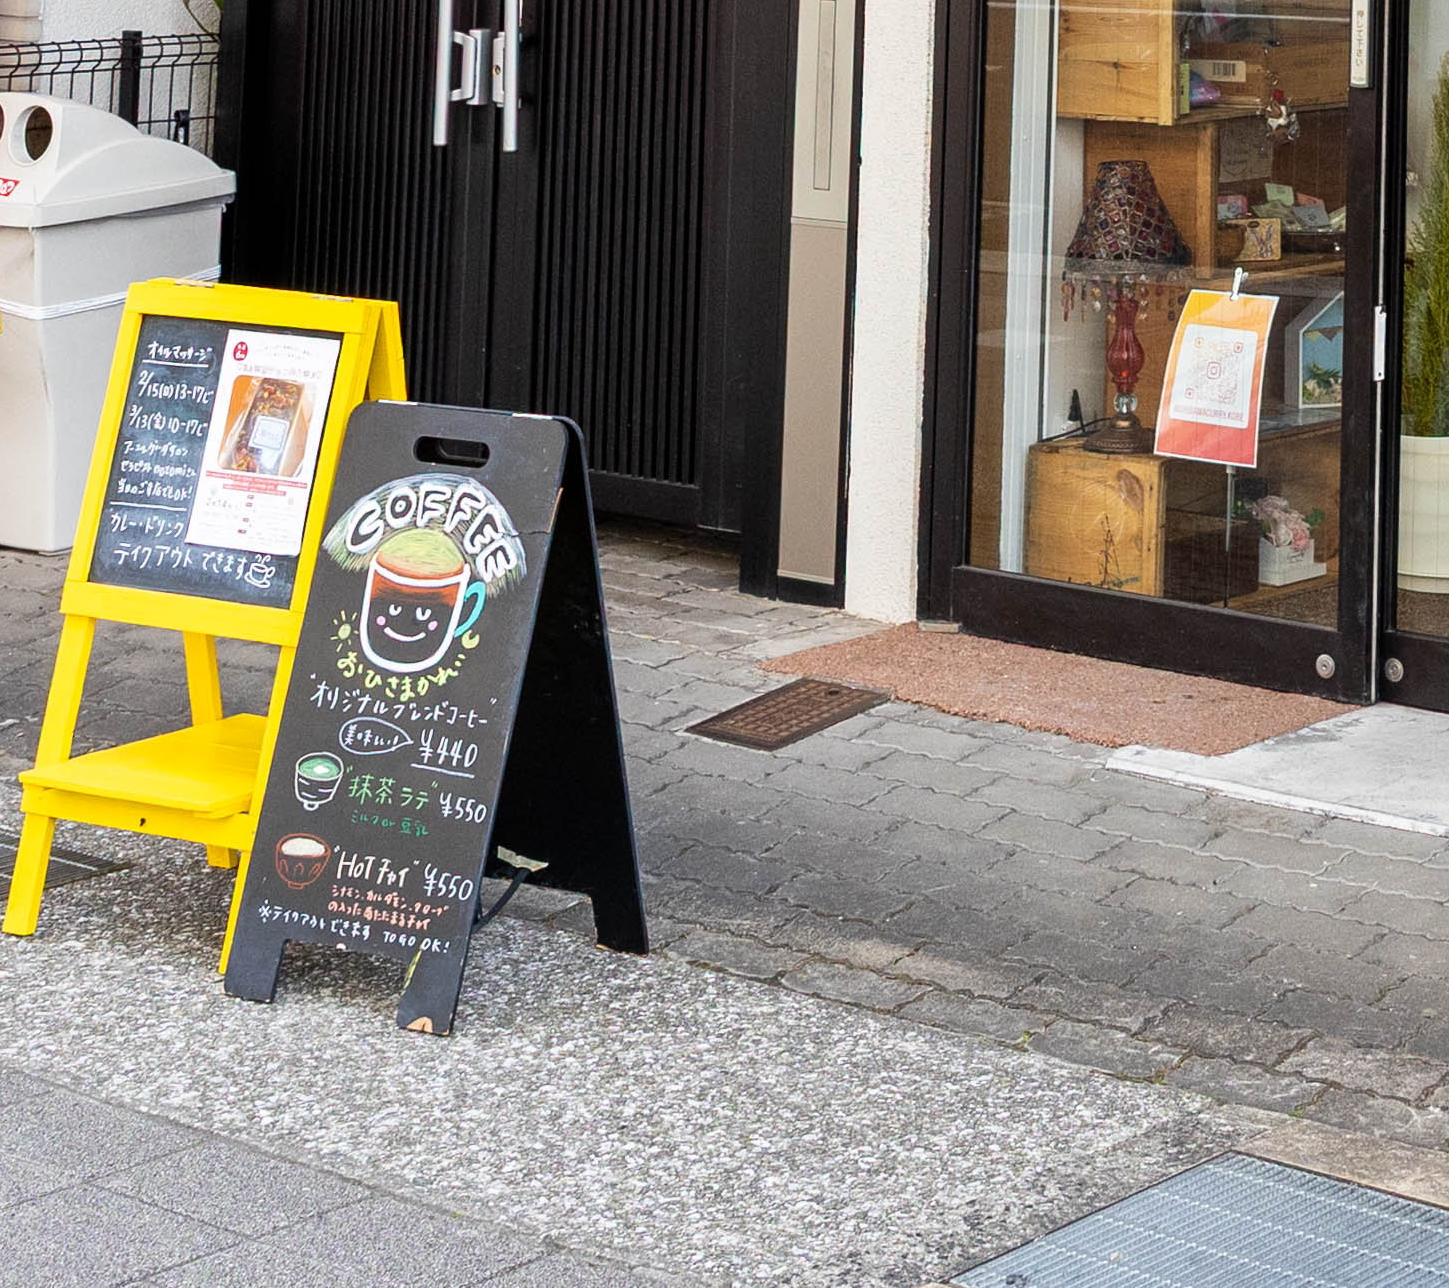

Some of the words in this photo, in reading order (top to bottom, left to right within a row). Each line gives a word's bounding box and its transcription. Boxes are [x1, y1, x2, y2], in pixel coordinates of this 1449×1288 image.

[345, 482, 517, 583] COFFEE
[113, 542, 193, 570] テイクアウト
[202, 549, 248, 581] できます
[420, 728, 478, 768] ¥440
[439, 792, 487, 823] ¥550
[424, 863, 473, 901] ¥550
